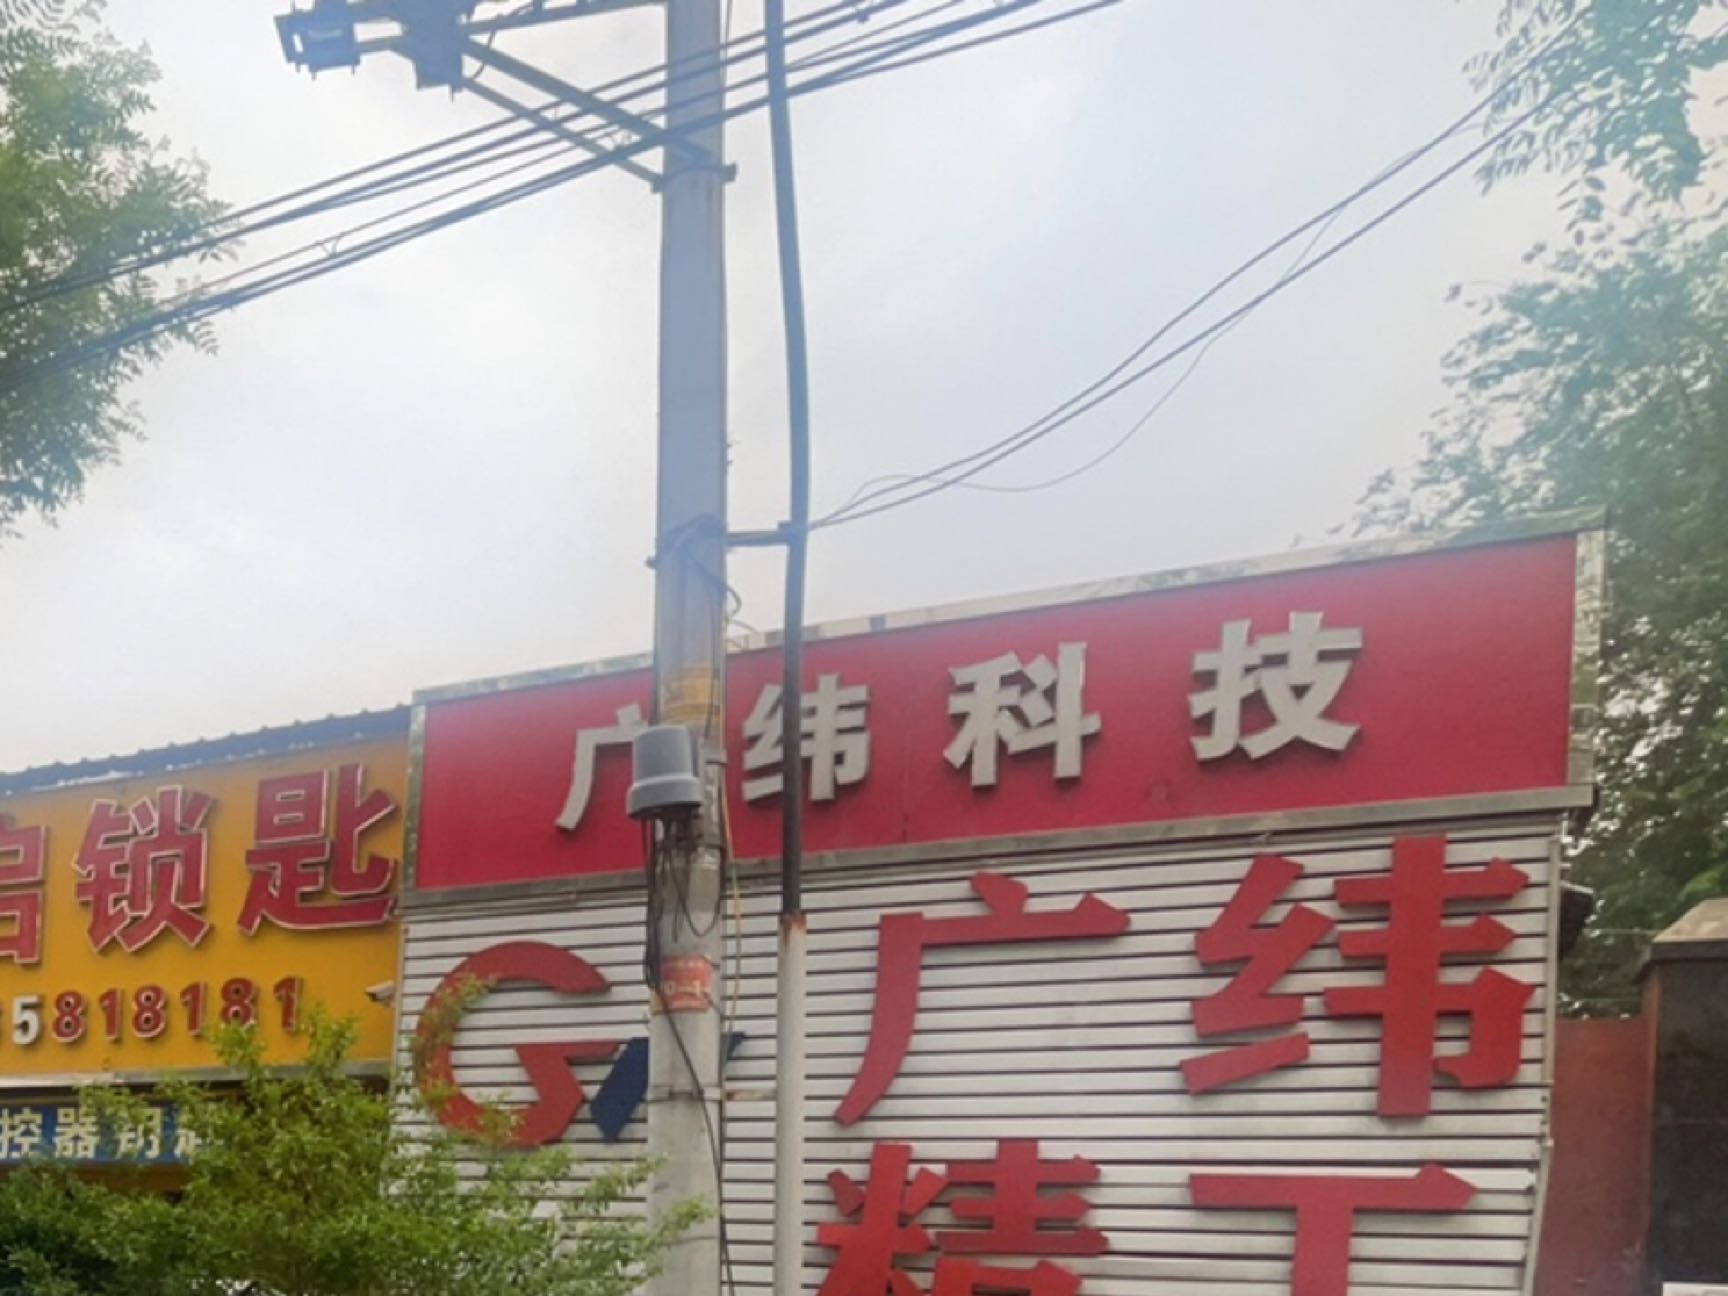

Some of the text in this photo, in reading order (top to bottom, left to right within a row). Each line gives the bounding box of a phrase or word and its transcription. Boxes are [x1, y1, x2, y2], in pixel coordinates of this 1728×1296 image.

[554, 611, 1364, 832] 广纬科技
[833, 835, 1534, 1127] 广纬
